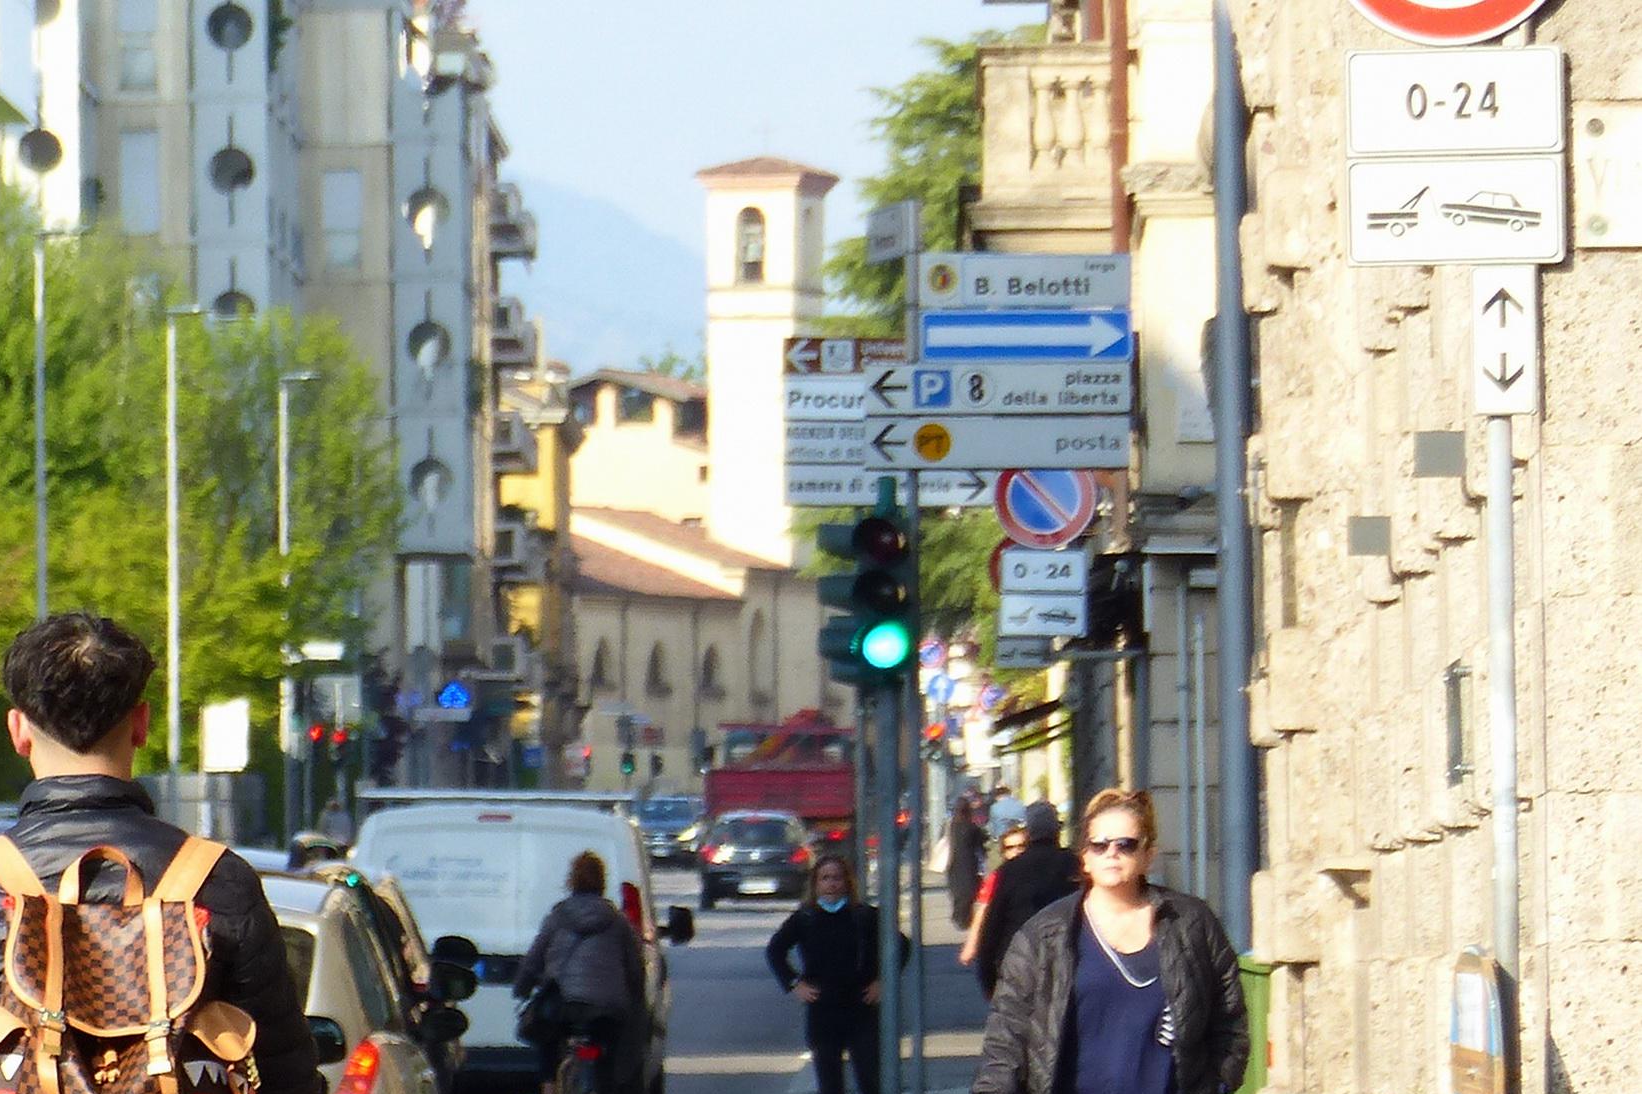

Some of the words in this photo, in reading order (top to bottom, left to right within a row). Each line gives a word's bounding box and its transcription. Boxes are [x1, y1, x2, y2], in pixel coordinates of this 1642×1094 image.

[1405, 81, 1500, 120] 0-24
[1007, 276, 1091, 296] Belotti
[1065, 371, 1122, 387] piazza
[1002, 390, 1049, 406] della
[1055, 434, 1122, 454] posta
